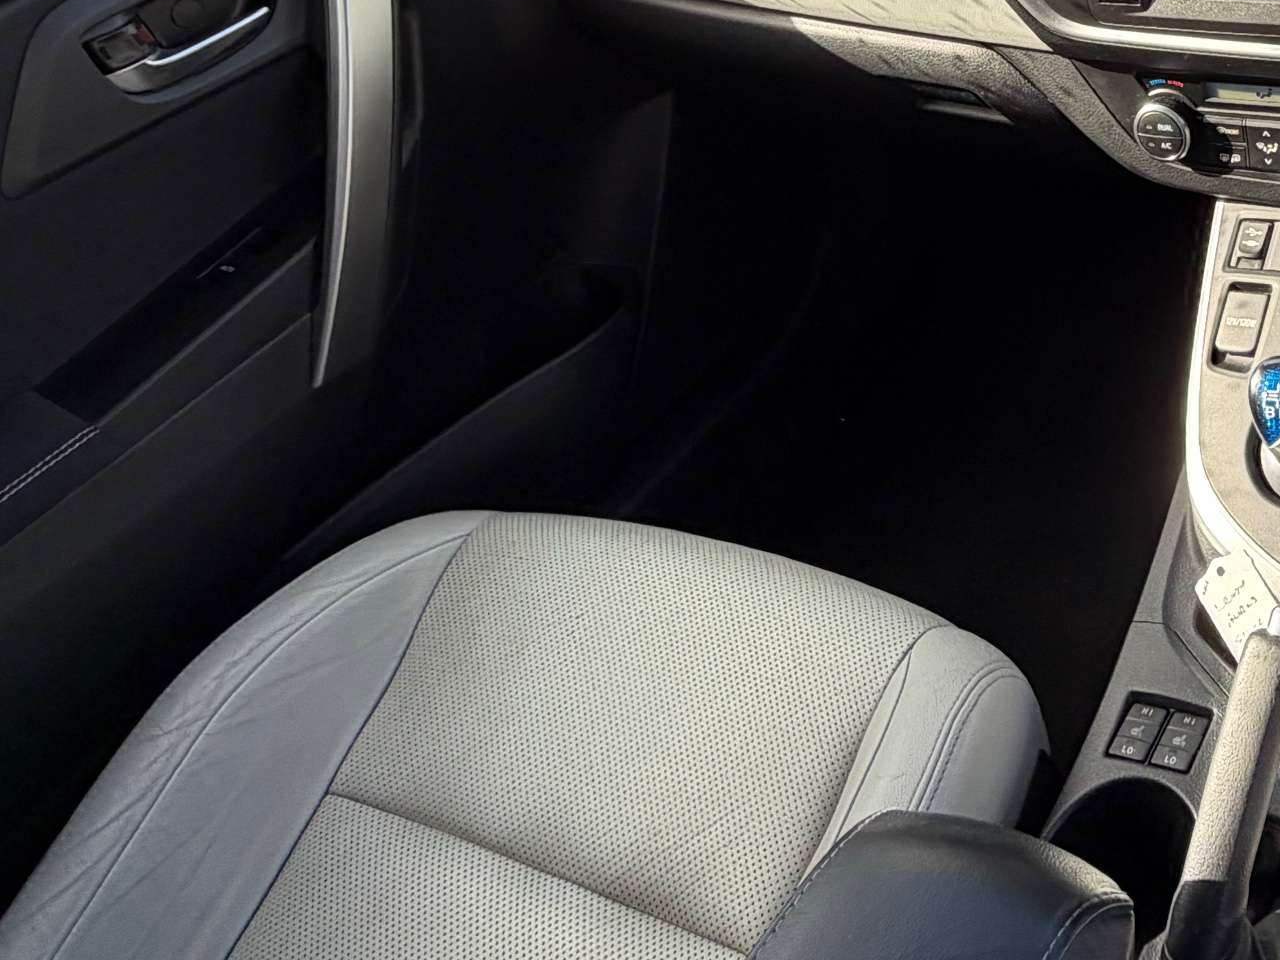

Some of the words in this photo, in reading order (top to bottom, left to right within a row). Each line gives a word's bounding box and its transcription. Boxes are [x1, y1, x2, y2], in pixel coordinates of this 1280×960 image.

[1265, 407, 1275, 419] B
[1140, 707, 1154, 717] HI
[1183, 716, 1196, 726] HI
[1121, 745, 1134, 755] LO
[1163, 754, 1177, 765] LO
